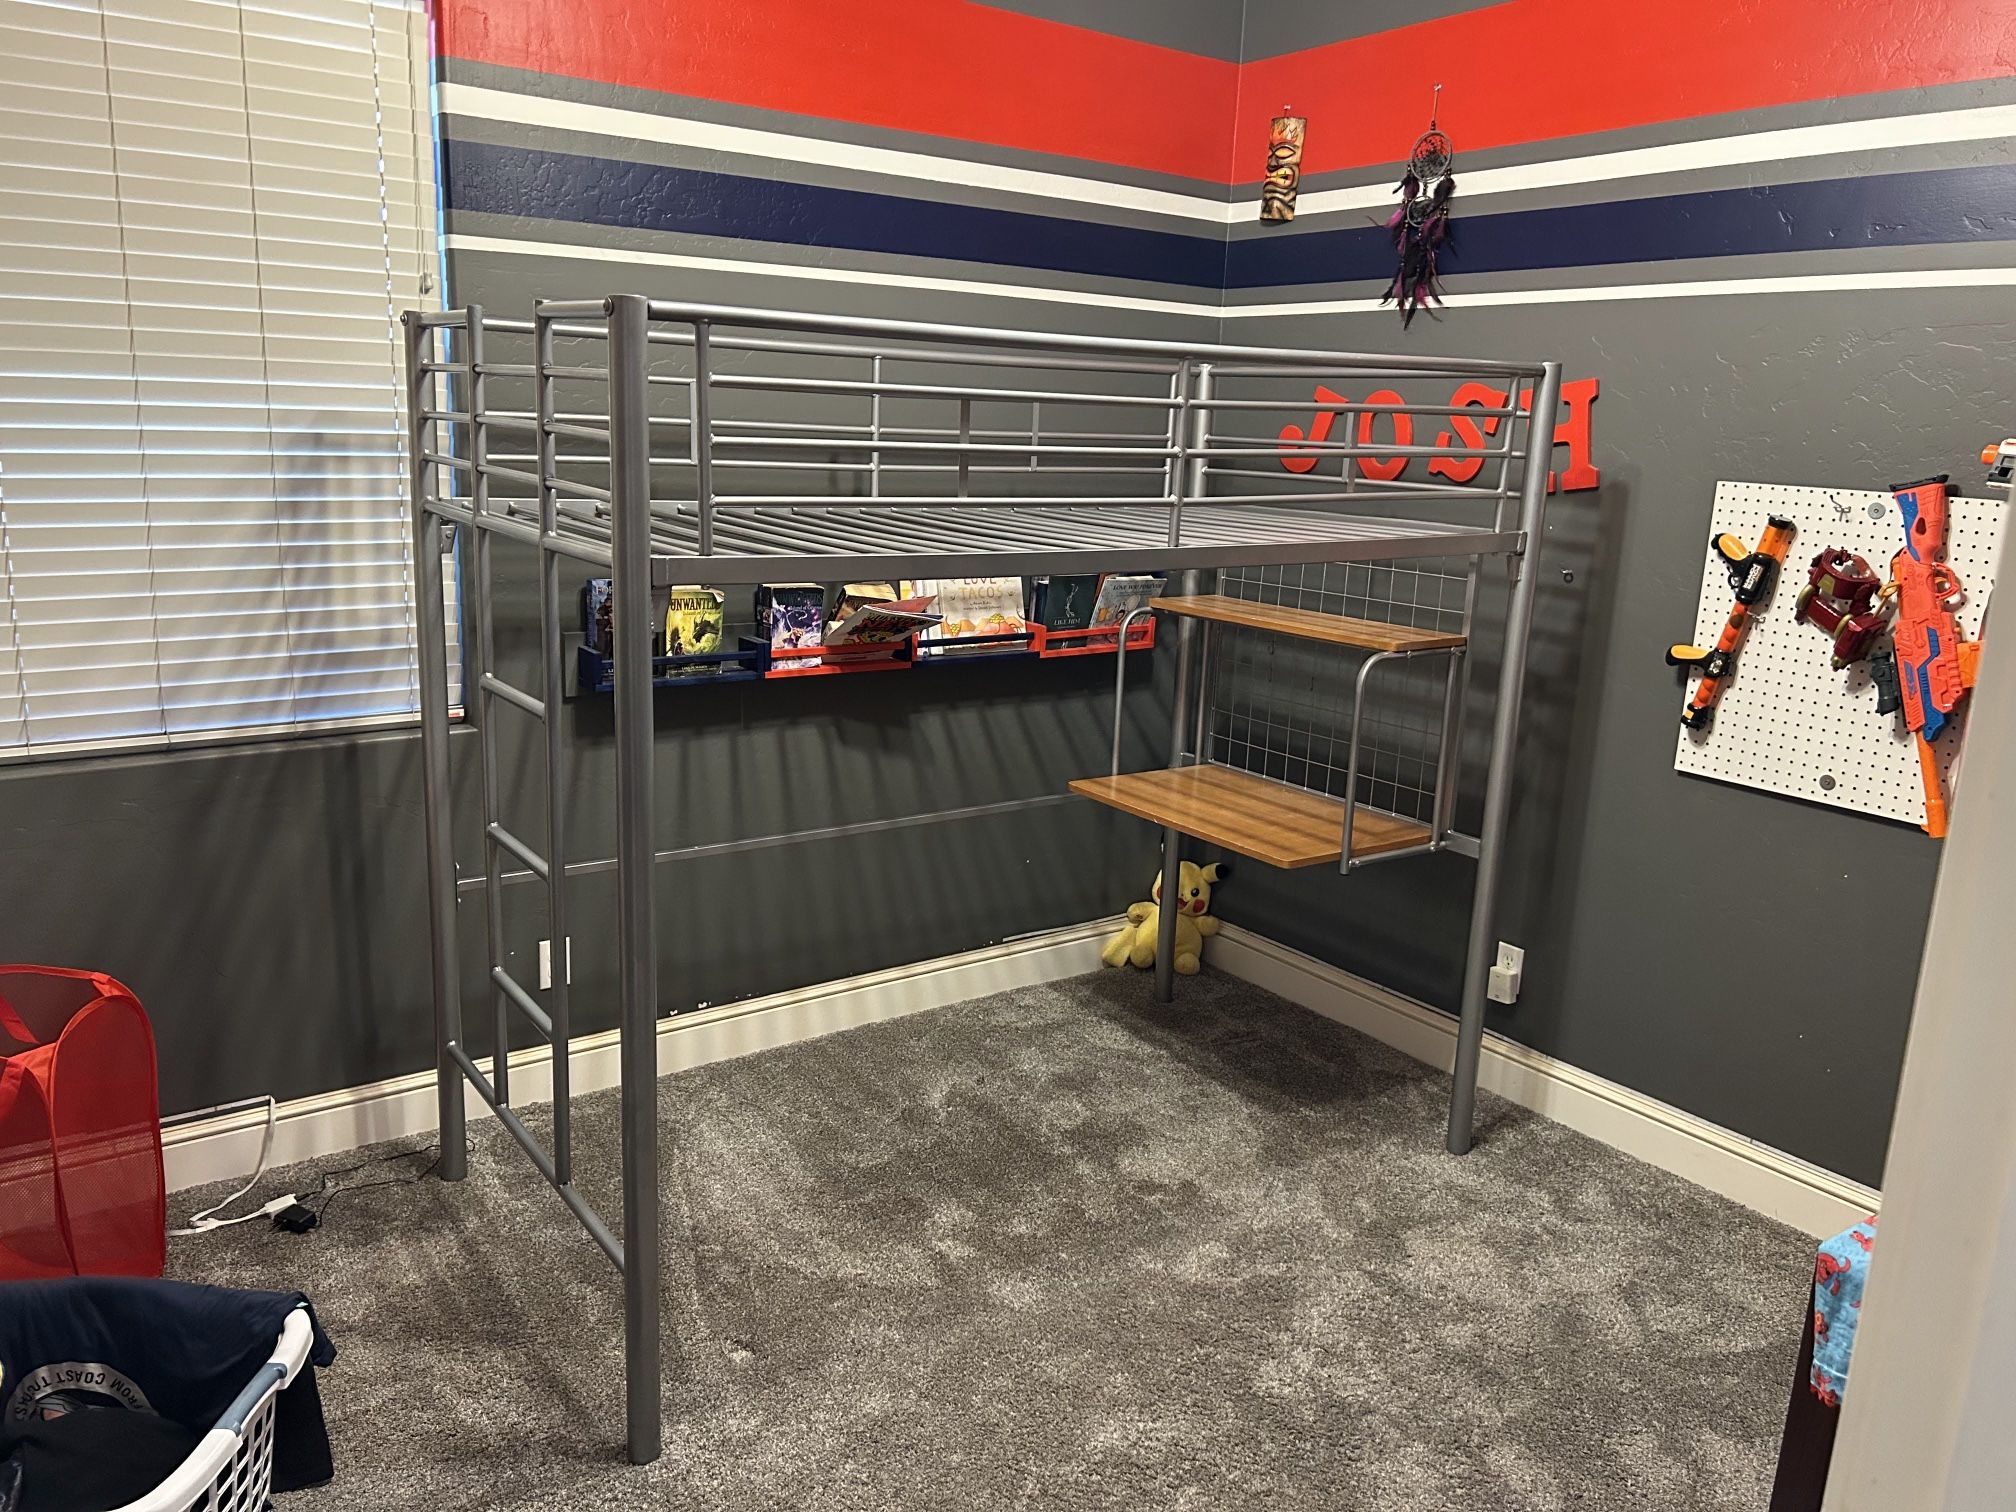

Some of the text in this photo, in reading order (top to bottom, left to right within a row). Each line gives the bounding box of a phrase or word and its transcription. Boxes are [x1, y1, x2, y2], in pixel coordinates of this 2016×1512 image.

[1278, 377, 1600, 493] JOSH
[959, 586, 1003, 600] TACOS
[55, 1370, 106, 1386] COAST
[111, 1378, 144, 1410] FROM
